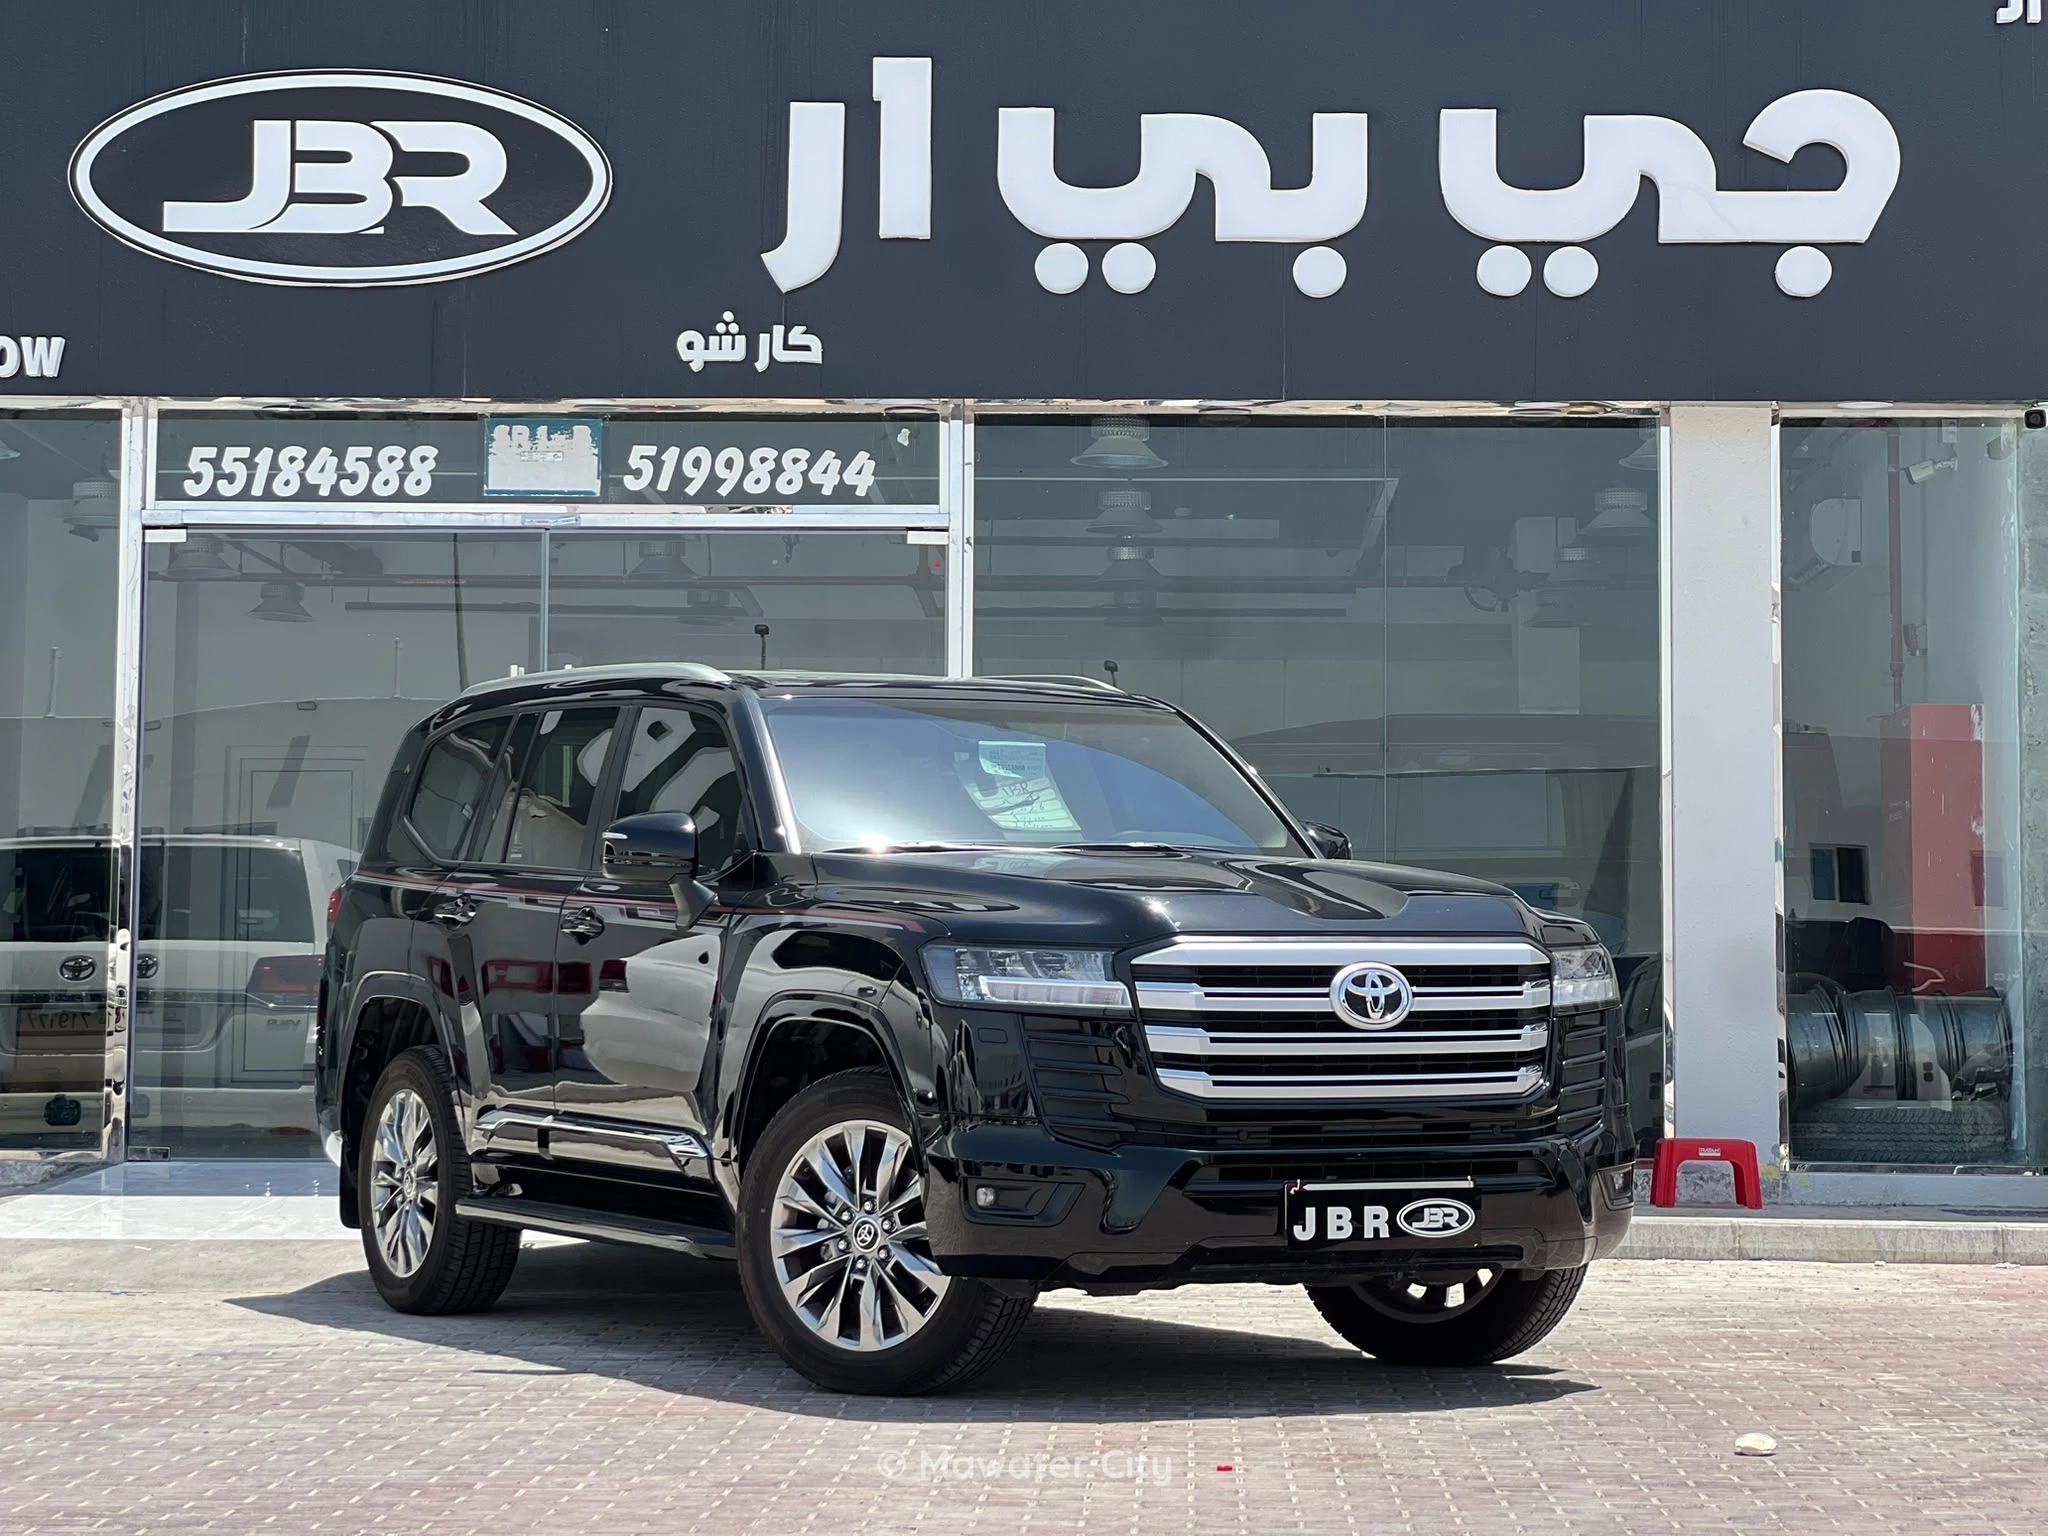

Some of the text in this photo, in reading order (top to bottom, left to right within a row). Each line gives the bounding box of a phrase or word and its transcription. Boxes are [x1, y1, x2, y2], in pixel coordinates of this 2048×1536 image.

[164, 120, 517, 234] JBR
[761, 57, 1900, 297] جي بي ار
[677, 311, 822, 372] كار شو
[184, 446, 438, 497] 55184588
[624, 445, 875, 496] 51998844
[1412, 1208, 1460, 1229] JBR
